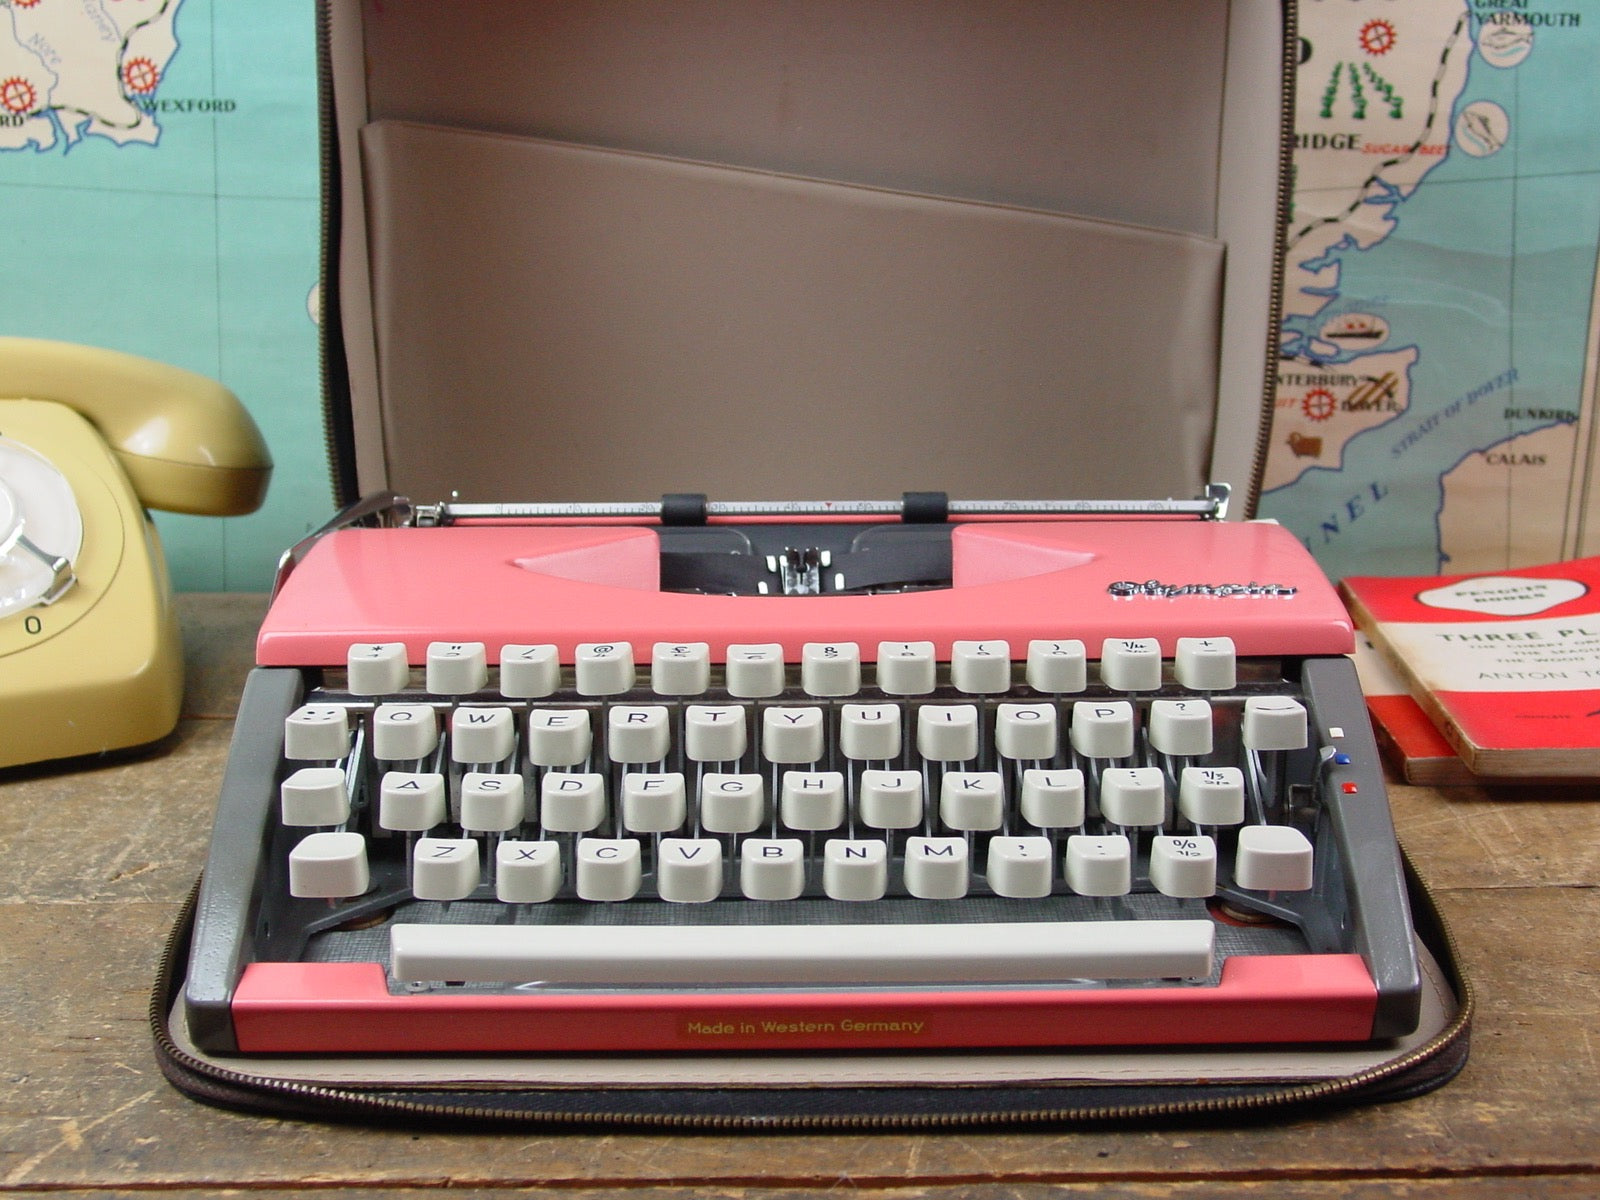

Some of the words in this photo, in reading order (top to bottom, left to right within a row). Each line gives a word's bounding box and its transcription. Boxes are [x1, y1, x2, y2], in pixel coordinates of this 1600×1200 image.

[1475, 12, 1581, 27] YARMOUTH
[142, 98, 237, 113] WEXFORD
[1391, 412, 1441, 459] STRAIT
[1466, 367, 1519, 405] DOVER
[1485, 453, 1547, 465] CALAIS
[1436, 631, 1545, 642] THREE
[593, 644, 614, 654] @
[1478, 671, 1569, 681] ANTON
[467, 712, 495, 725] W
[546, 715, 569, 728] E
[627, 711, 650, 724] R
[704, 710, 727, 723] T
[783, 713, 804, 725] Y
[860, 710, 882, 721] U
[1094, 707, 1116, 719] P
[396, 779, 421, 791] A
[477, 779, 502, 791] S
[559, 779, 583, 792] D
[642, 779, 665, 791] F
[719, 780, 744, 793] G
[802, 778, 824, 790] H
[881, 777, 902, 789] J
[962, 778, 984, 791] K
[1044, 776, 1067, 788] L
[431, 845, 456, 859] Z
[515, 848, 538, 861] X
[595, 846, 619, 860] C
[678, 846, 701, 861] V
[762, 845, 784, 859] B
[844, 846, 868, 859] N
[923, 844, 954, 858] M
[688, 1021, 735, 1035] Made
[740, 1021, 756, 1034] in
[761, 1020, 836, 1034] Western
[840, 1019, 925, 1034] Germany
